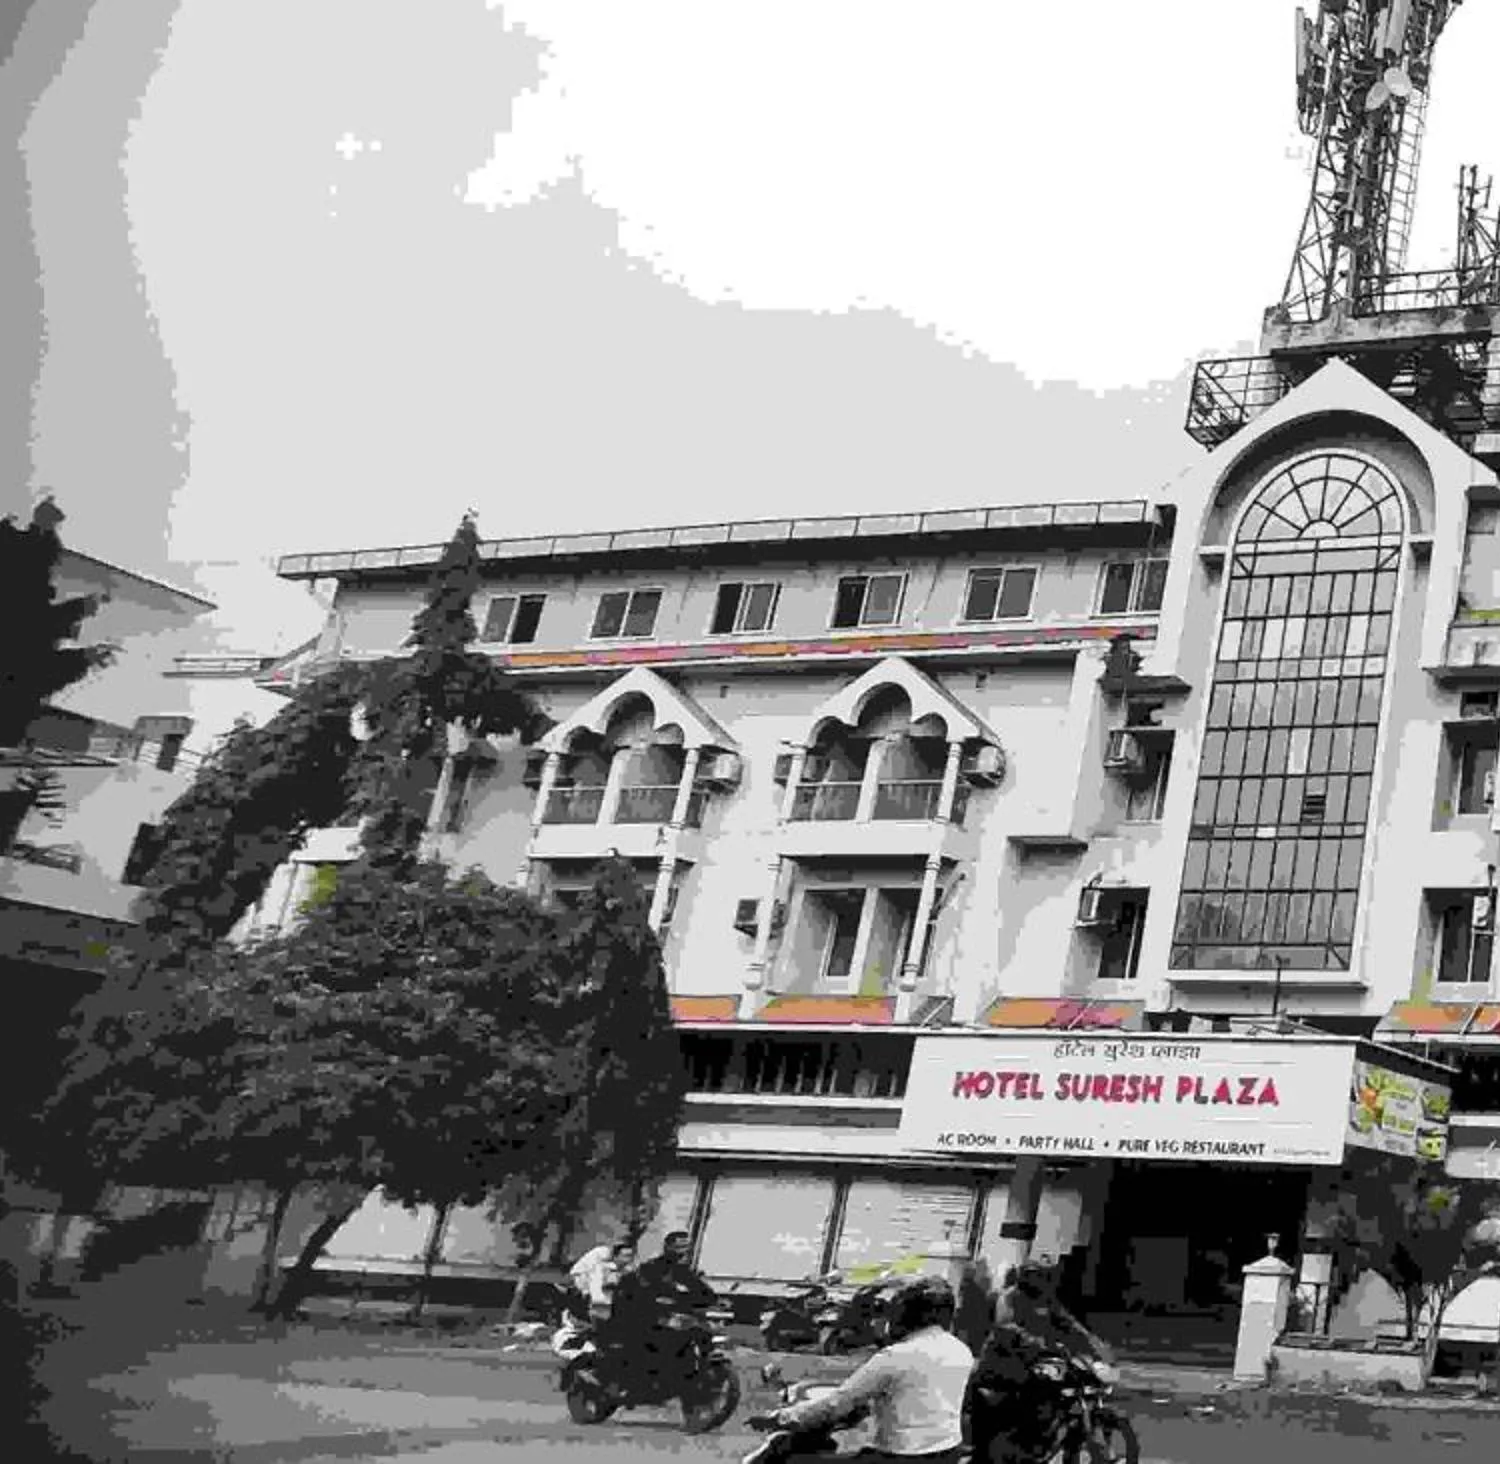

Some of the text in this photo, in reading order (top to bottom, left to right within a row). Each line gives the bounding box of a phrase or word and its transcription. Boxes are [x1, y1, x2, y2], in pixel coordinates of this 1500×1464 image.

[1053, 1039, 1095, 1058] हॉटेल
[952, 1071, 1280, 1106] HOTEL SURESH PLAZA
[937, 1133, 955, 1146] AC
[957, 1133, 997, 1148] ROOM
[1019, 1135, 1059, 1149] PARTY
[1063, 1137, 1095, 1151] HALL
[1117, 1139, 1151, 1153] PURE
[1155, 1140, 1180, 1154] VEG
[1183, 1141, 1266, 1157] RESTAURANT
